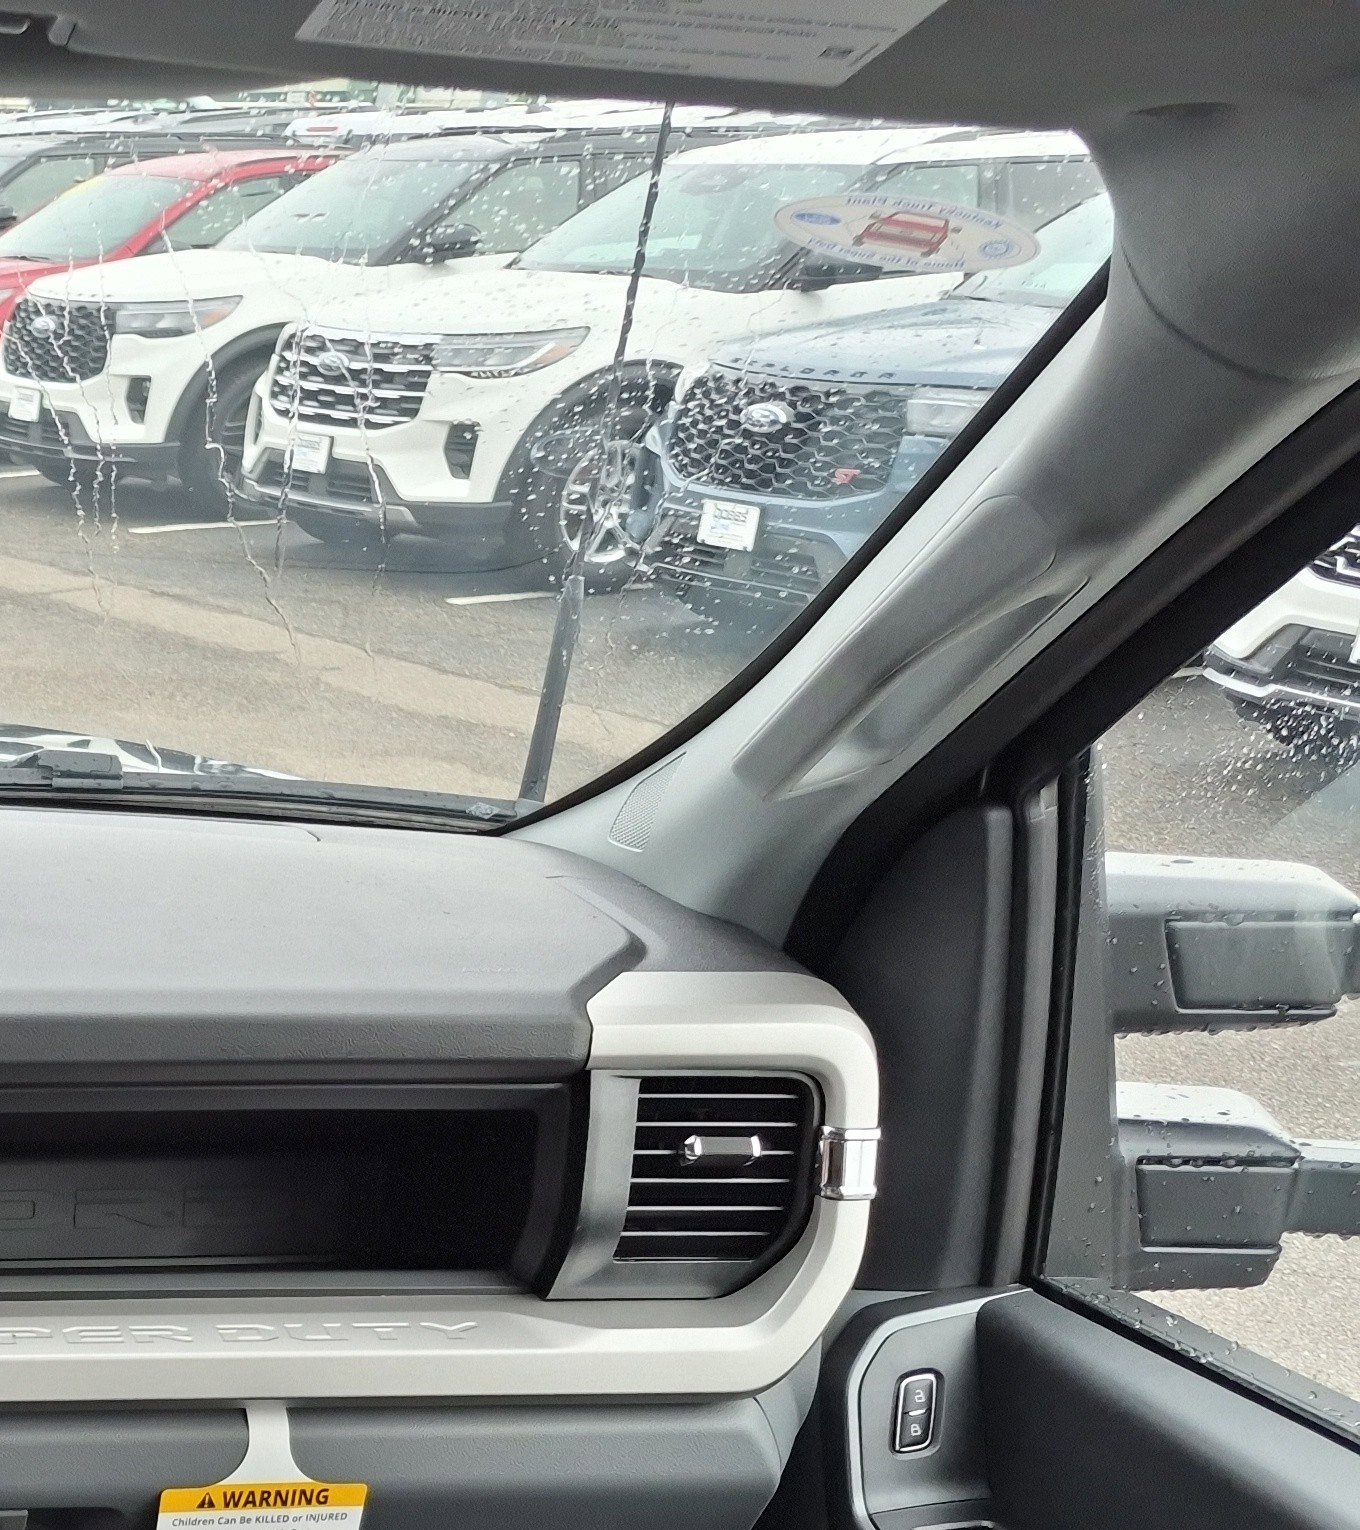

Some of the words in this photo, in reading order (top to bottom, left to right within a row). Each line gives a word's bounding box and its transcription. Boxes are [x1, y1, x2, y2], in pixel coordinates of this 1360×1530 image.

[215, 1321, 479, 1343] DUTY
[223, 1488, 330, 1508] WARNING
[172, 1518, 215, 1527] Children
[217, 1516, 236, 1525] Can
[240, 1516, 252, 1524] Be
[255, 1515, 290, 1523] KILLED
[306, 1513, 348, 1523] INJURED
